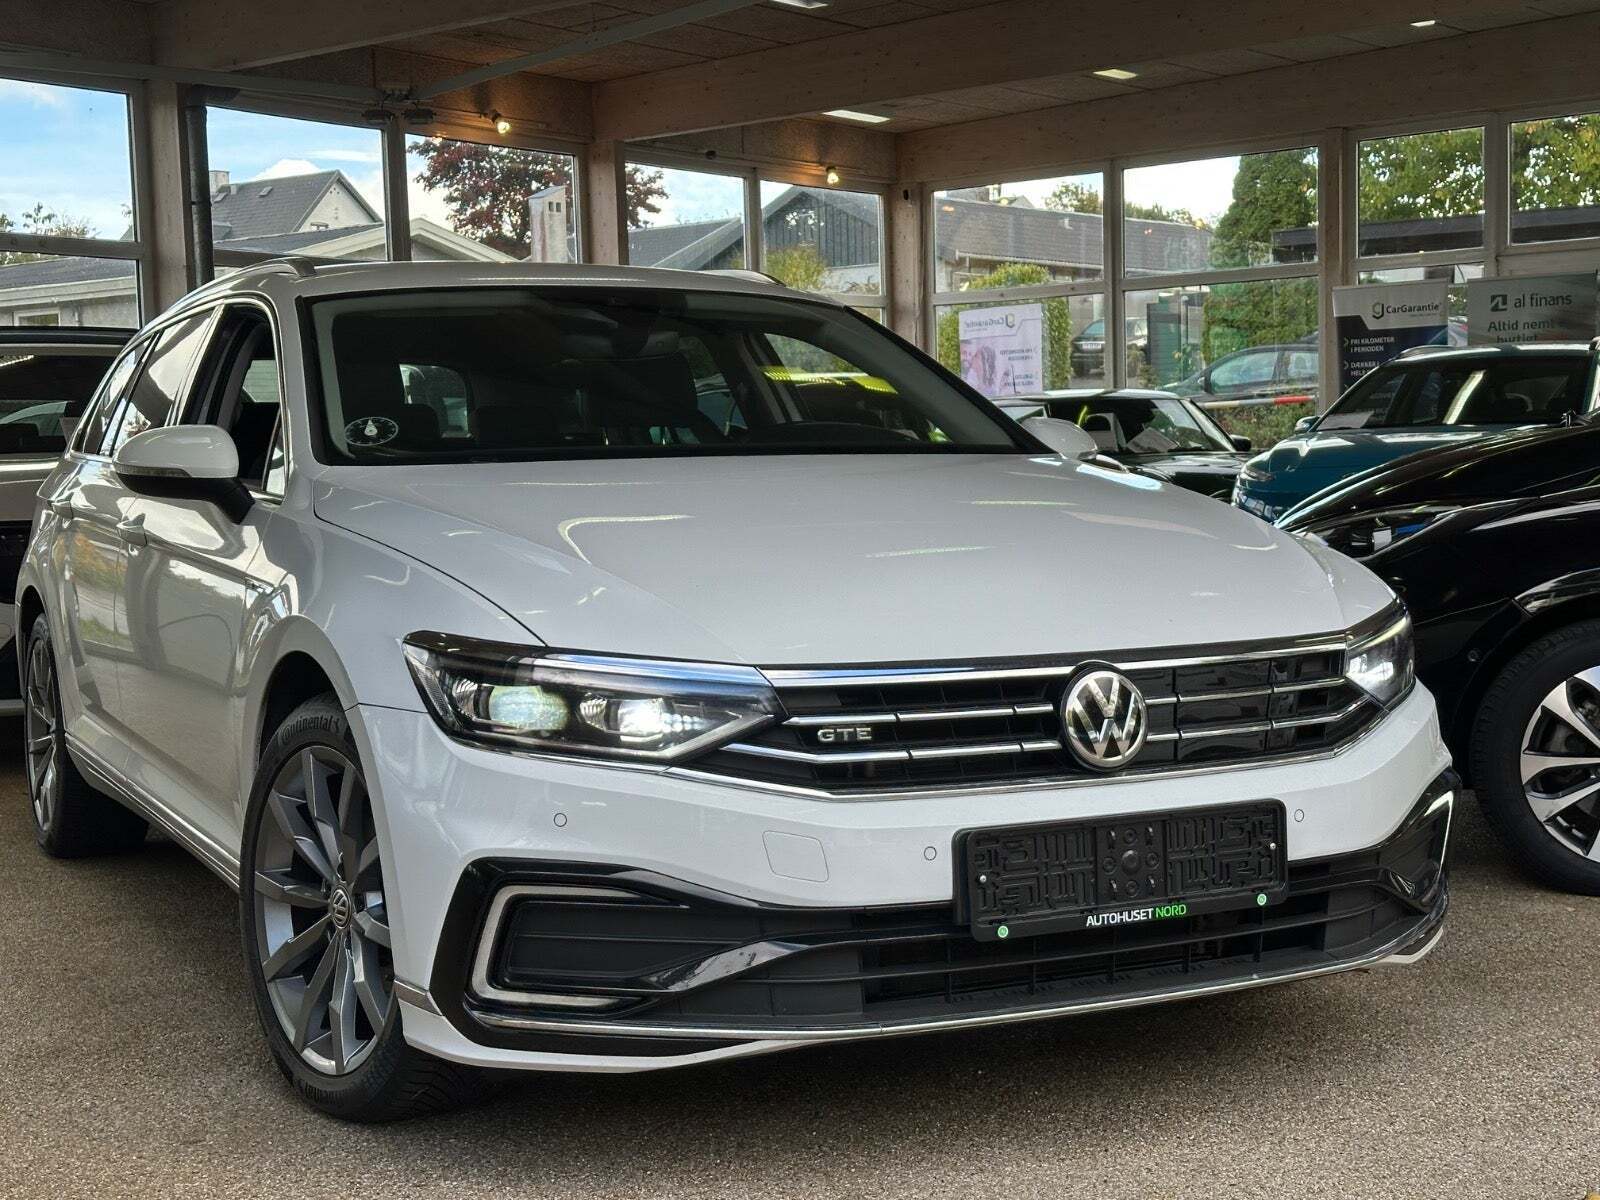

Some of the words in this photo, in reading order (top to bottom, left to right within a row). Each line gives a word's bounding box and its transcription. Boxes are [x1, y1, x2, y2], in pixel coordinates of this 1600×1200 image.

[1386, 303, 1439, 314] CarGarantie
[1514, 294, 1525, 309] al
[1530, 293, 1572, 308] finans
[1488, 320, 1518, 332] Altid
[818, 727, 872, 742] GTE
[1086, 908, 1154, 926] AUTOHUSET
[1155, 904, 1187, 918] NORD
